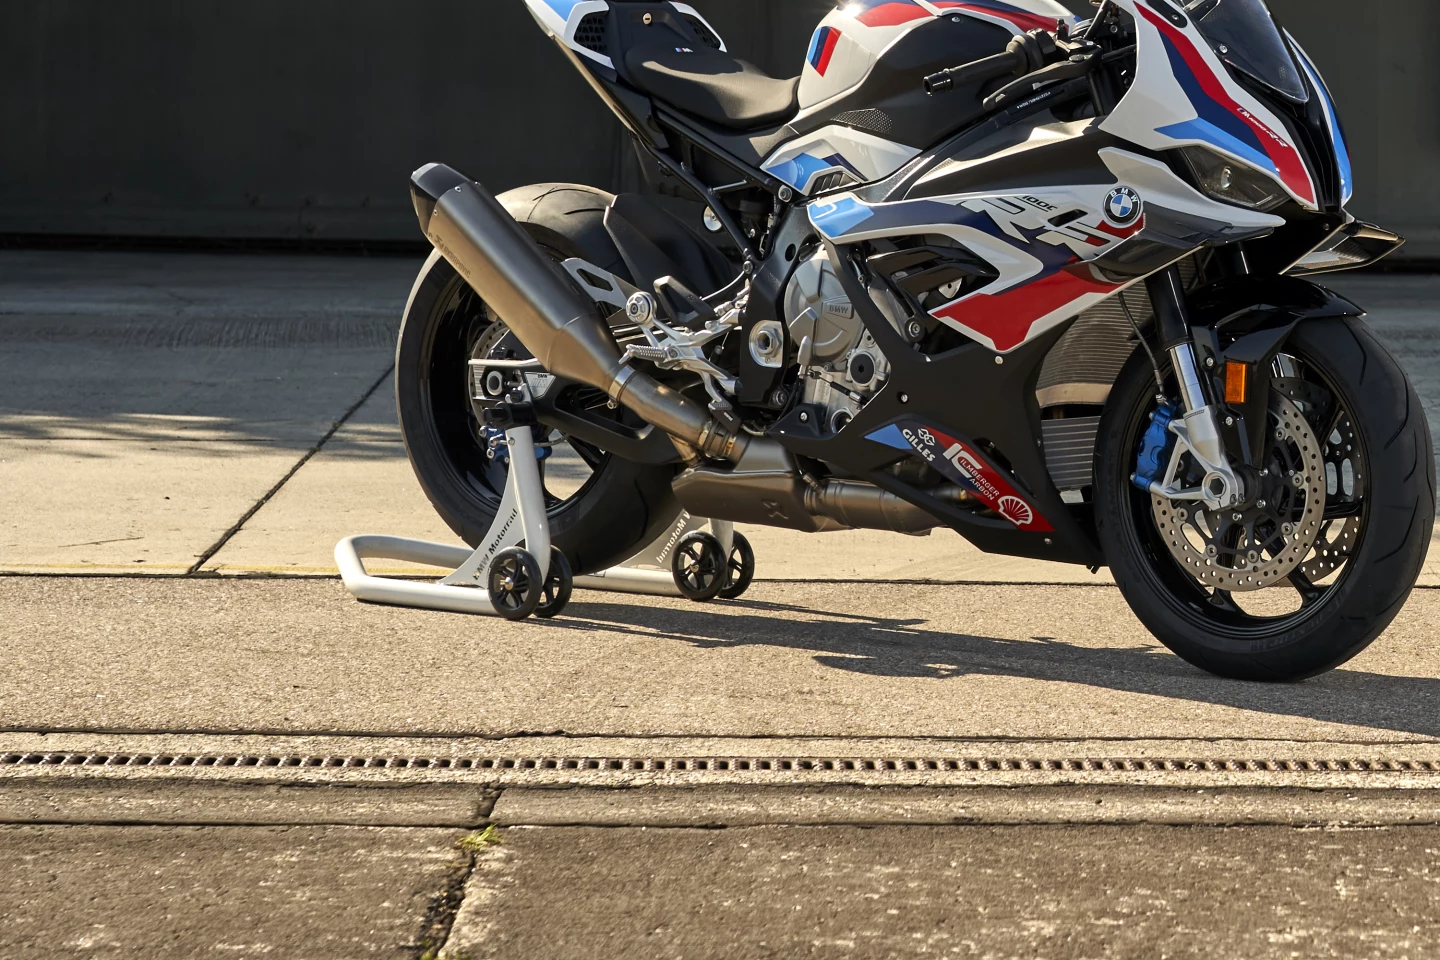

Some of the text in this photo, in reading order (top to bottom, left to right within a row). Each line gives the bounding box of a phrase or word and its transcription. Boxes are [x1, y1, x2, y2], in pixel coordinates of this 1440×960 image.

[828, 304, 849, 314] BMW
[902, 428, 936, 462] GILLES
[960, 458, 1000, 497] ILMBERGER
[488, 508, 518, 555] Motorrad
